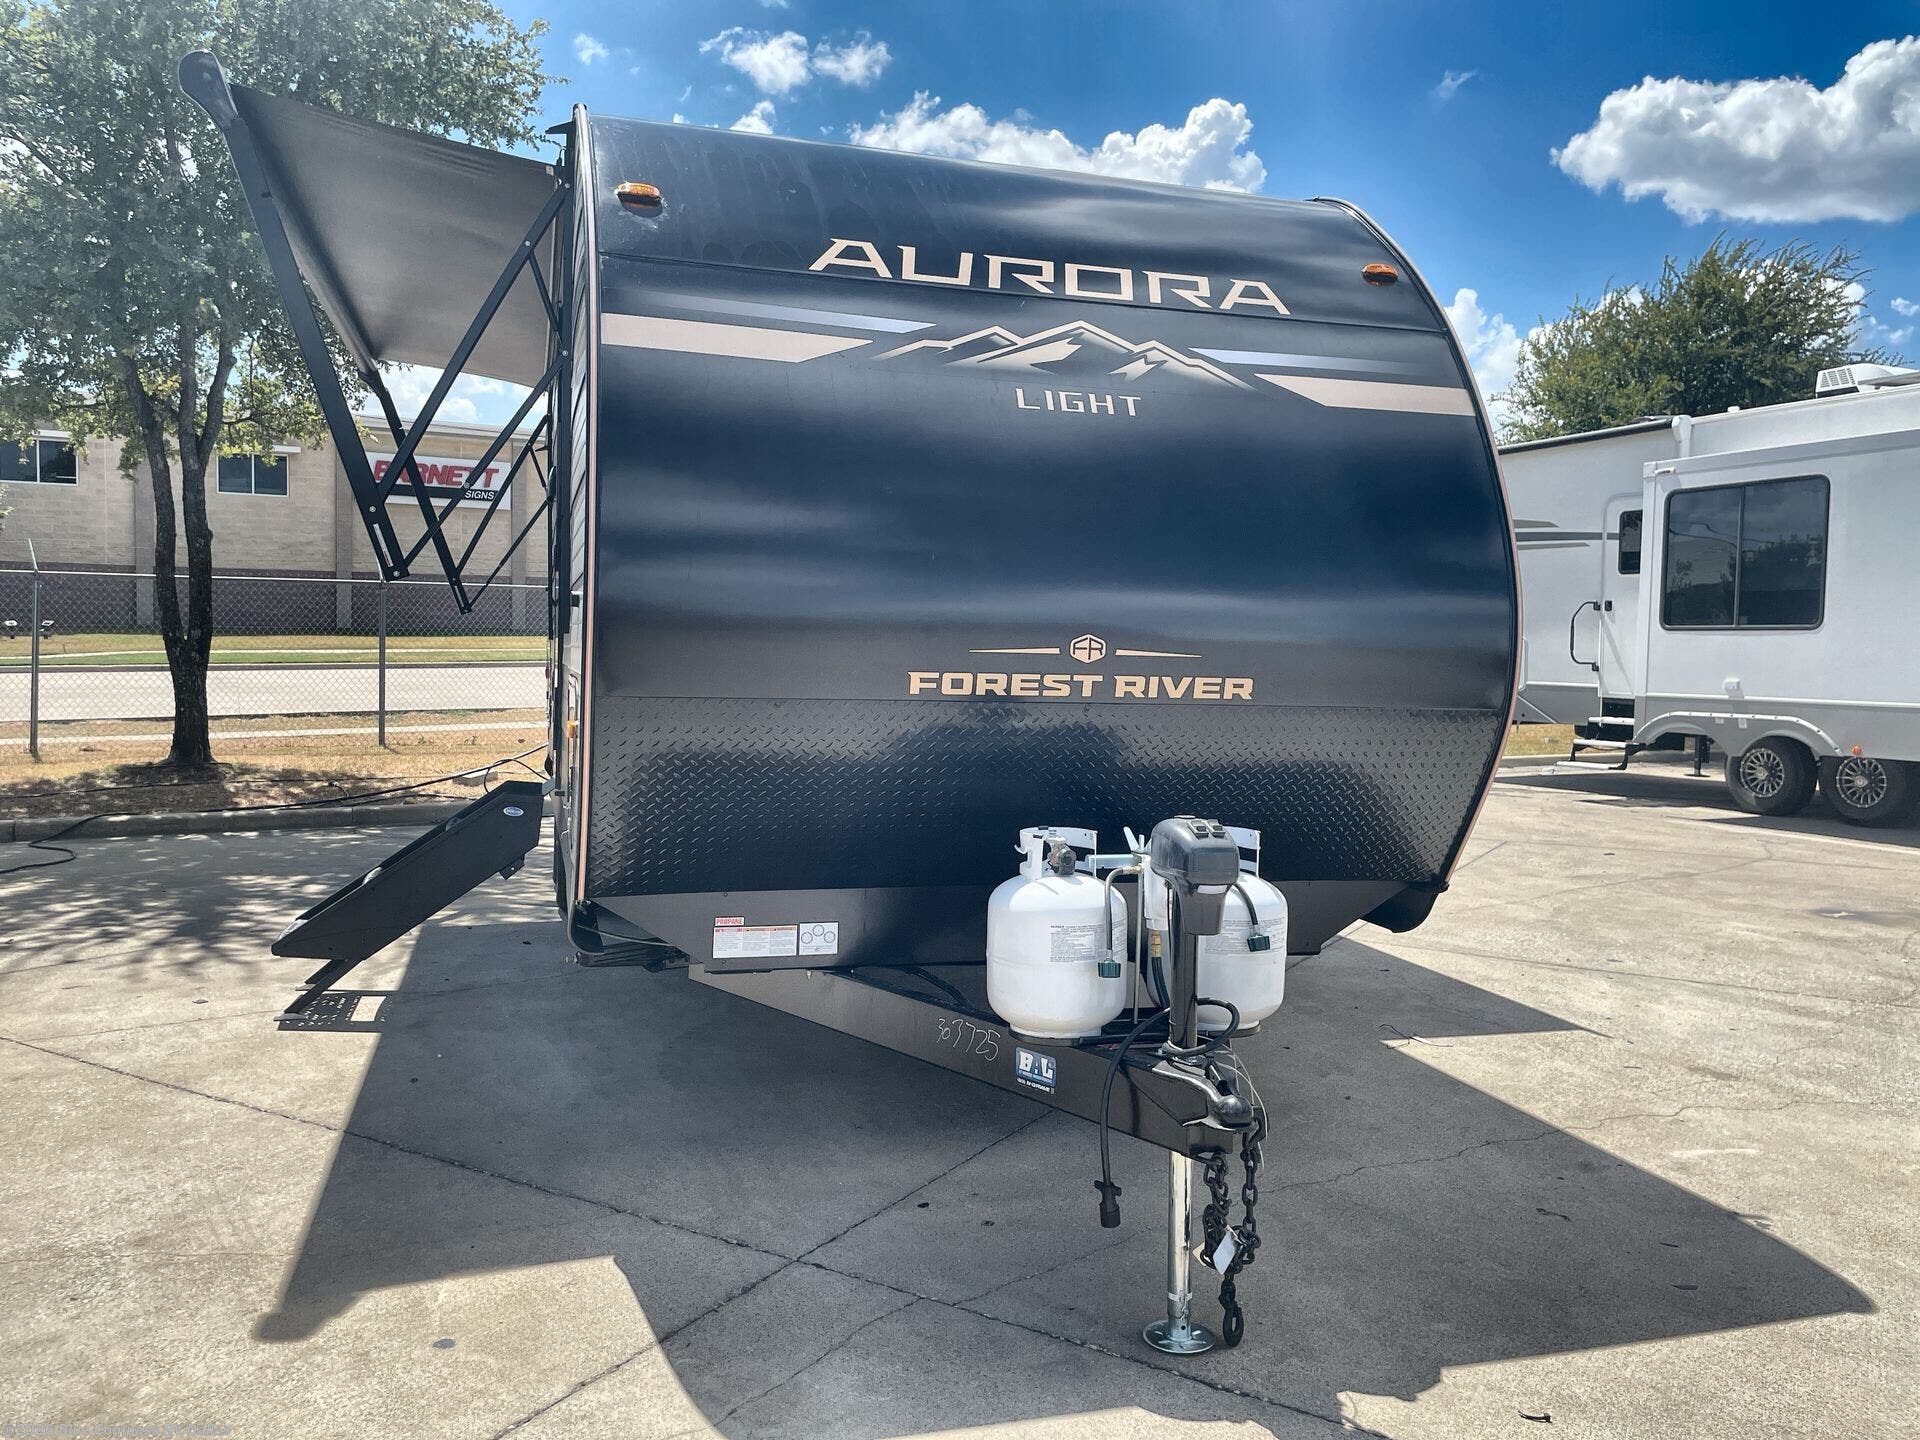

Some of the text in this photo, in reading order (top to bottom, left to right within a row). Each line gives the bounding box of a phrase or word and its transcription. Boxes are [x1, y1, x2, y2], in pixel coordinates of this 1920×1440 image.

[808, 237, 1291, 315] AURORA
[1015, 387, 1142, 417] LIGHT
[464, 490, 495, 500] SIGNS
[907, 671, 1255, 700] FOREST RIVER
